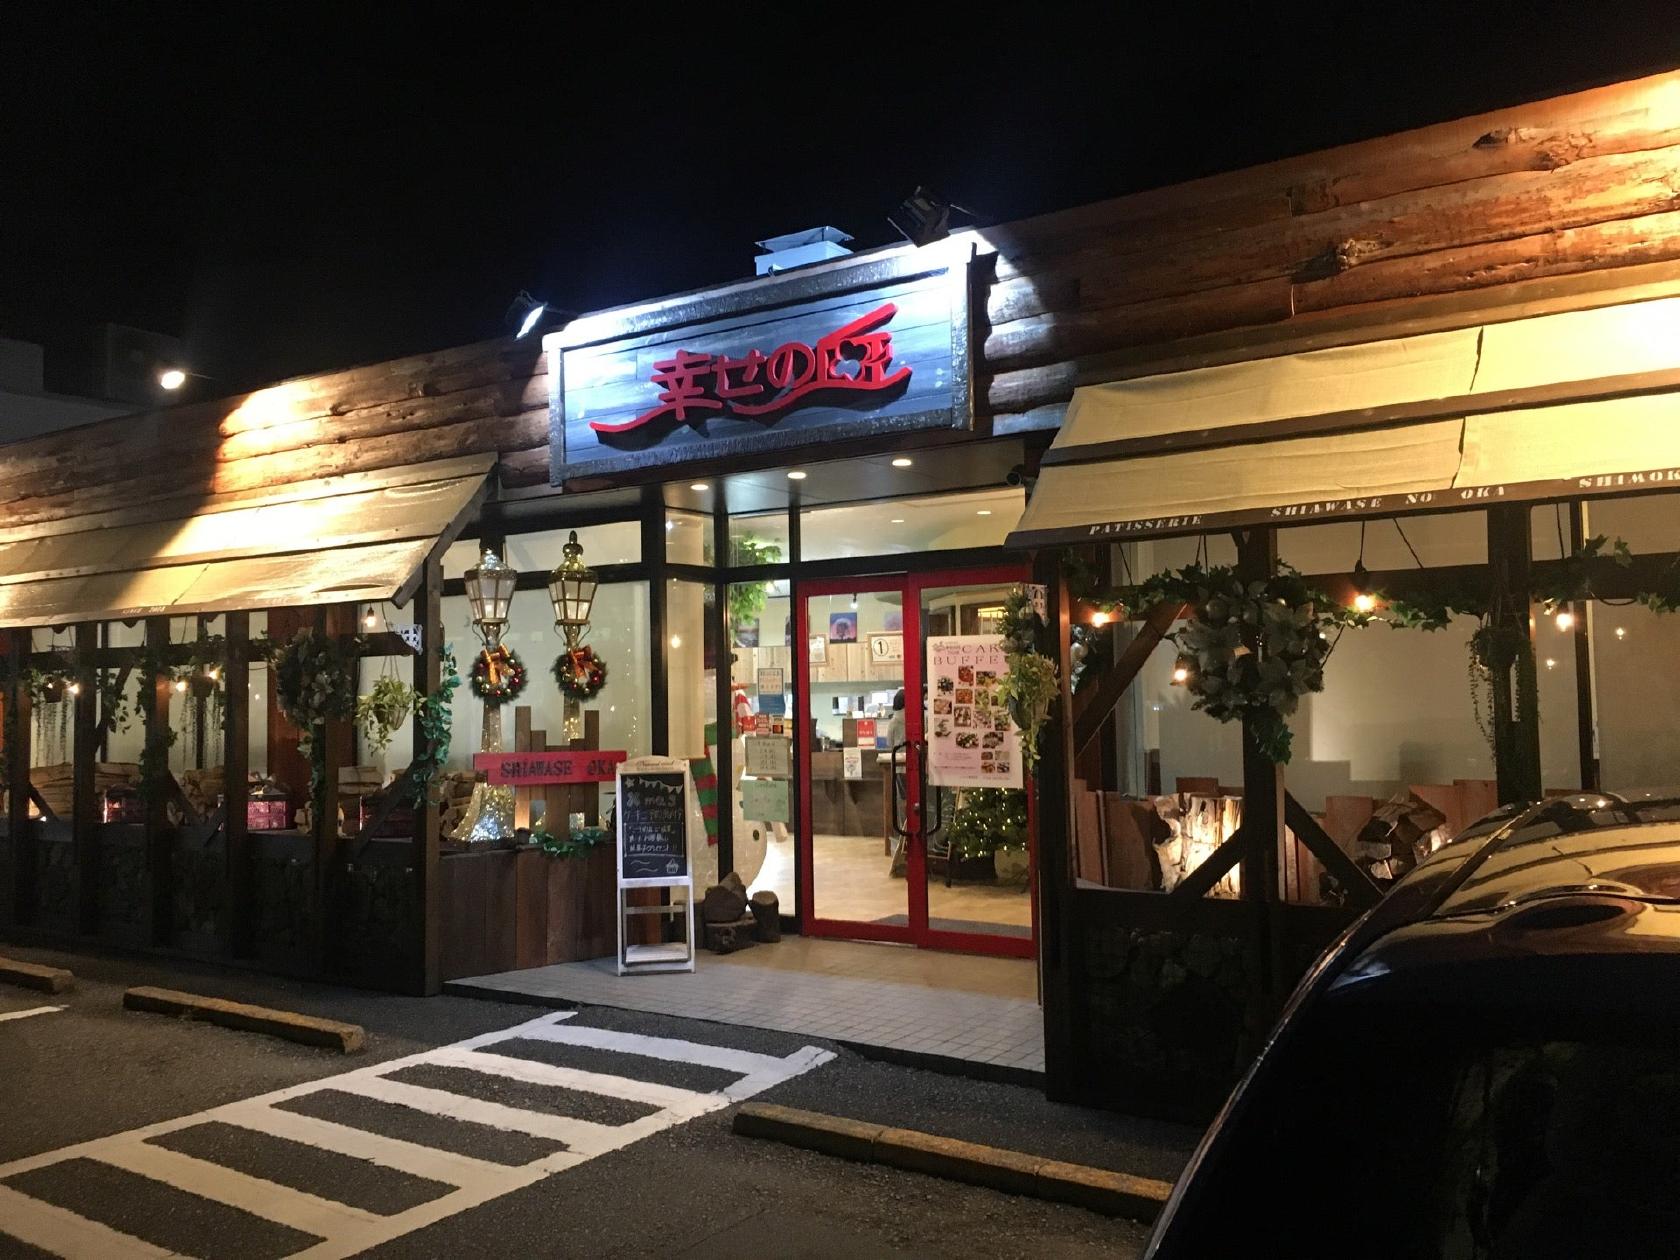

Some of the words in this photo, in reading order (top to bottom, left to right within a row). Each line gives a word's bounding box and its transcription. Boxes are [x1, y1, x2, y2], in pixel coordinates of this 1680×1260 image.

[1089, 515, 1202, 535] PATISSERIE
[1270, 496, 1383, 517] SHIAWASE
[1405, 493, 1433, 505] NO
[1460, 486, 1506, 500] OKA
[961, 644, 1000, 655] CAK
[933, 655, 999, 666] BUFFE
[500, 759, 573, 778] SHIAWASE
